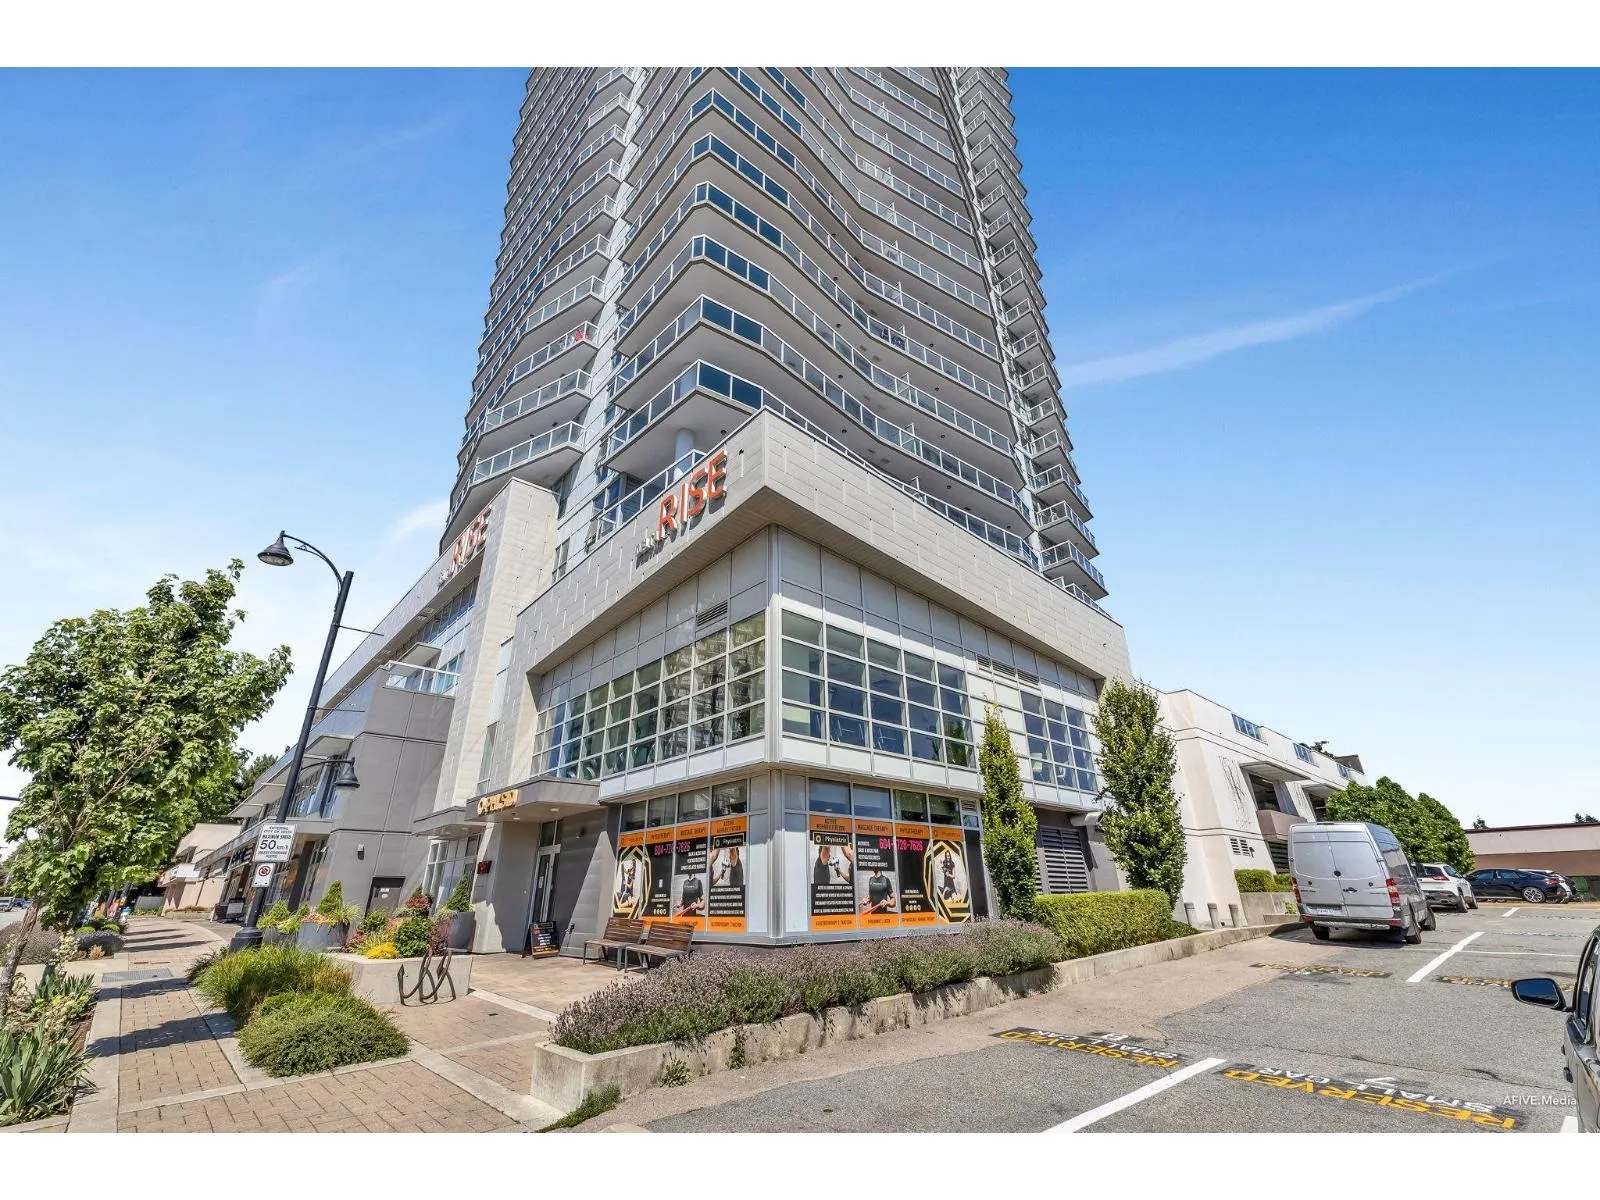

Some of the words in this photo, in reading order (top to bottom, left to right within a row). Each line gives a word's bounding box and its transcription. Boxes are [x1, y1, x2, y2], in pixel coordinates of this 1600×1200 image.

[657, 449, 727, 541] RISE
[260, 840, 276, 850] 50
[1030, 1030, 1080, 1041] CAR
[999, 1031, 1180, 1068] RESERVED
[1091, 1039, 1178, 1059] SMALL
[1258, 1067, 1331, 1083] CAR
[1224, 1069, 1515, 1129] RESERVED
[1344, 1080, 1494, 1112] SMALL
